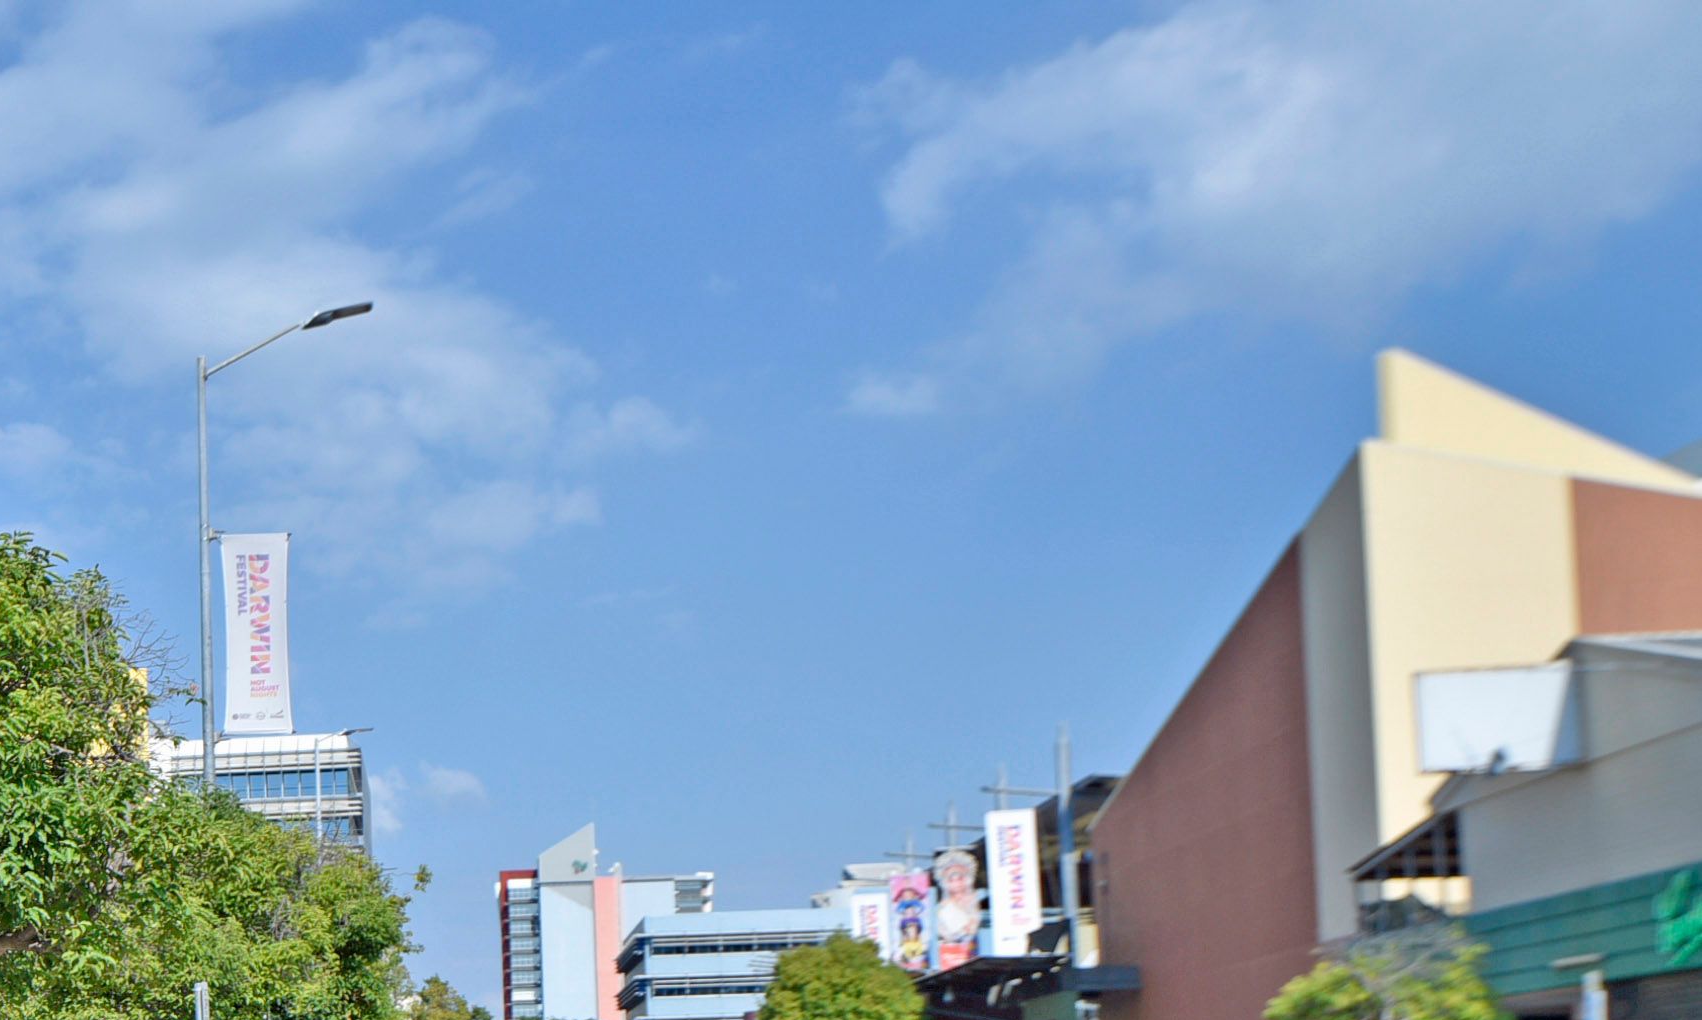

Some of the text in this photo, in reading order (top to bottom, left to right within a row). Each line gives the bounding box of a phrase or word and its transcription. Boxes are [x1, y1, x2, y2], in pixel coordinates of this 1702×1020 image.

[236, 554, 247, 616] FESTIVAL
[249, 554, 271, 674] DARWIN
[1007, 824, 1026, 909] DARWIN
